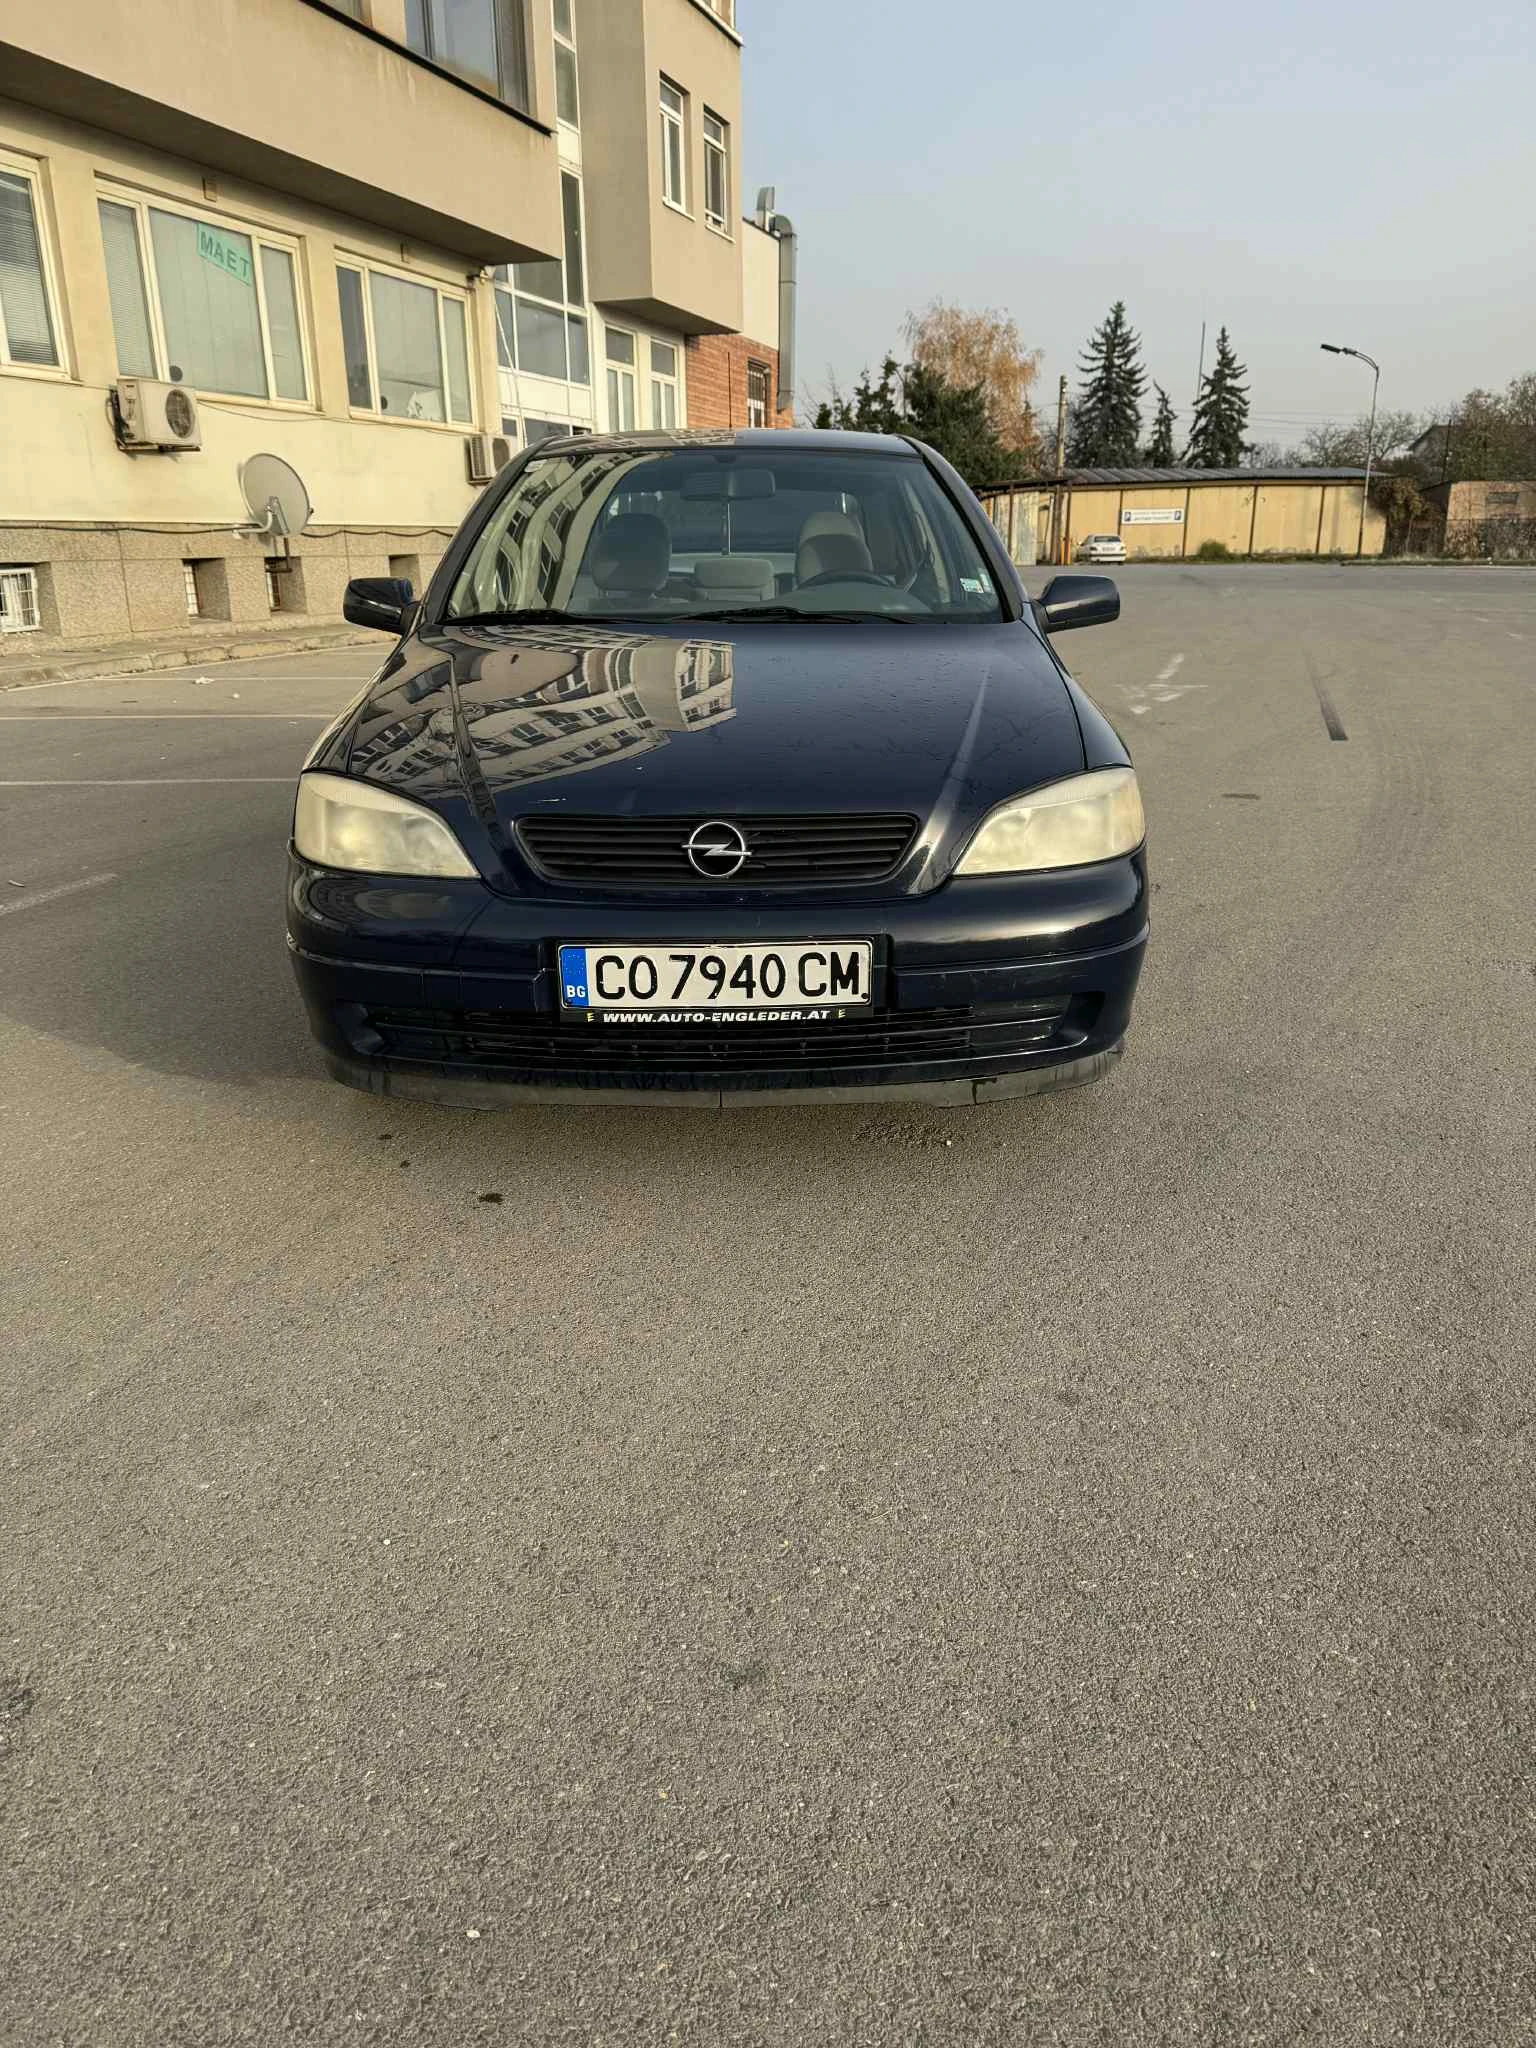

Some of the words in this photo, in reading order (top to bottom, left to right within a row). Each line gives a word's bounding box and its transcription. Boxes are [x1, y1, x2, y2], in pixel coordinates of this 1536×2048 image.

[669, 953, 786, 1000] 7940
[798, 951, 860, 997] CM
[566, 984, 586, 998] BG
[603, 1010, 831, 1023] WWW.AUTO-ENGLEDER.AT
